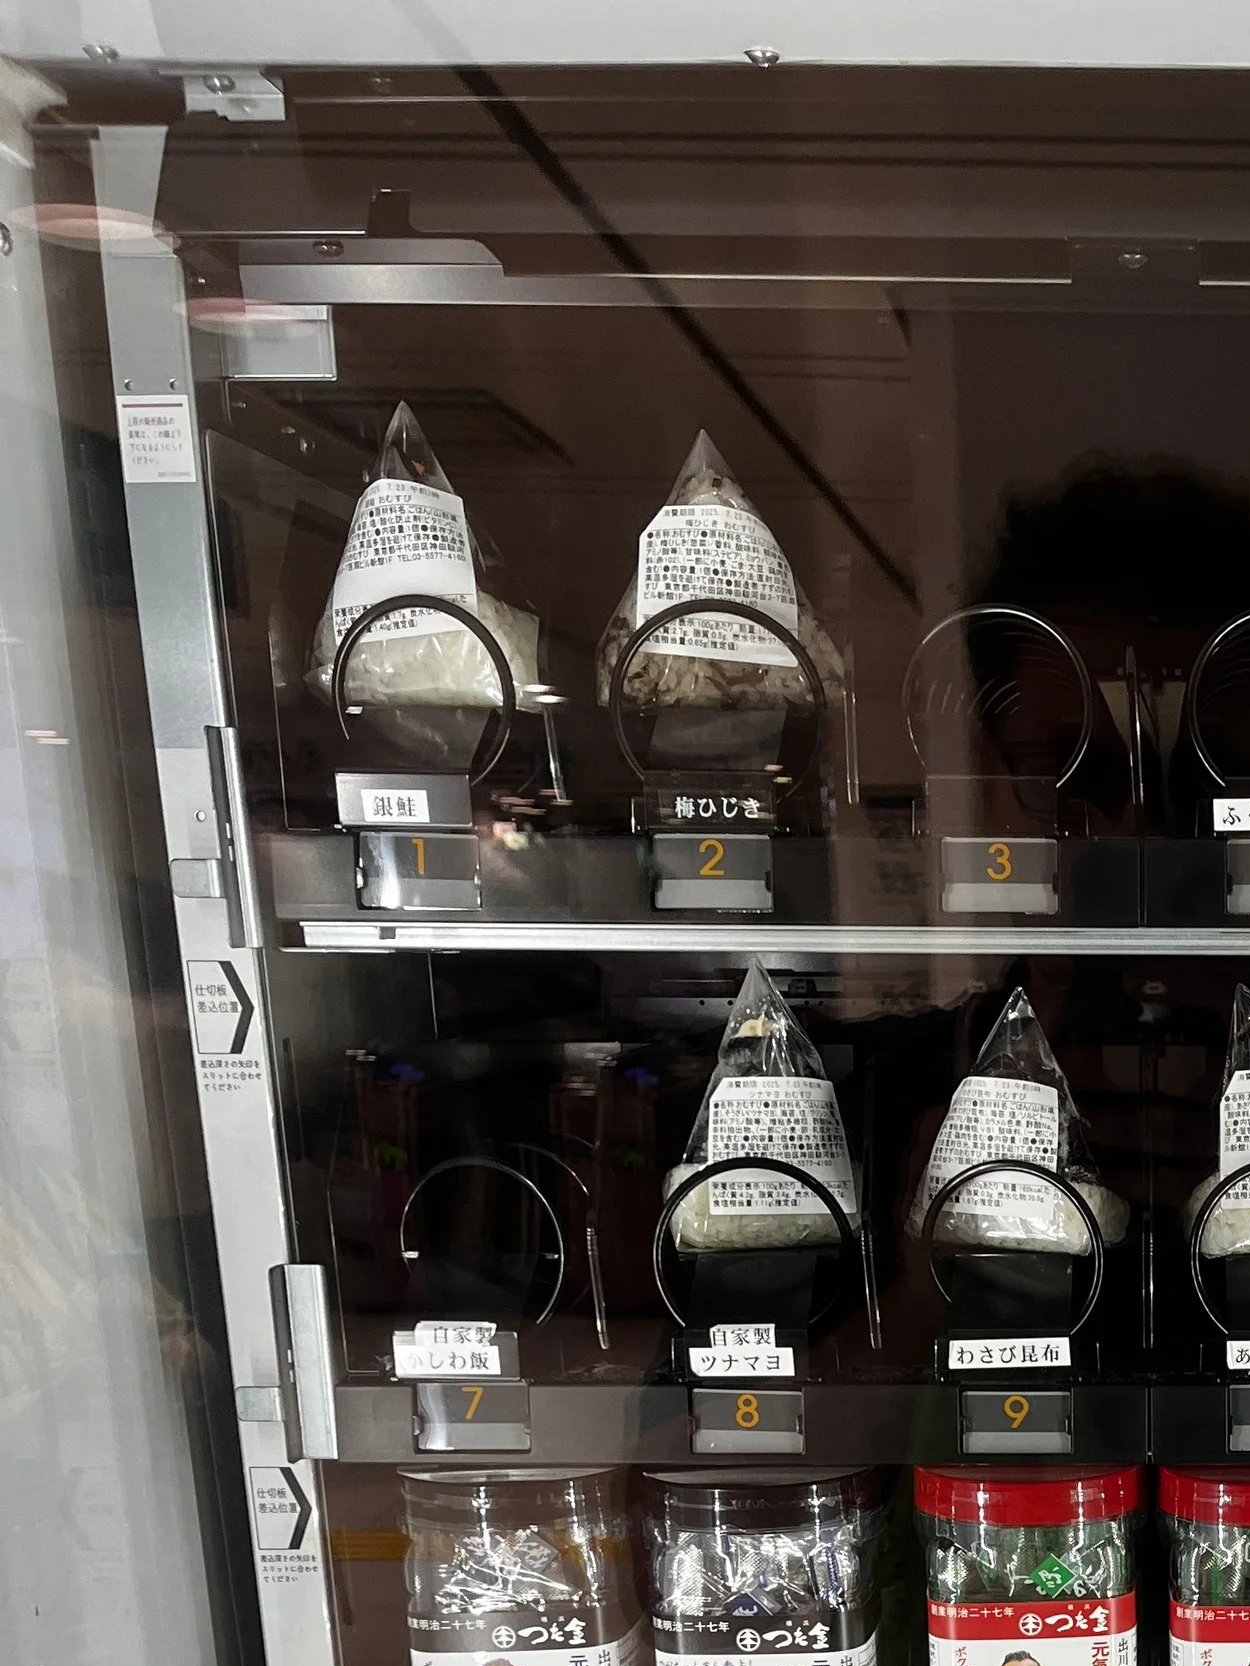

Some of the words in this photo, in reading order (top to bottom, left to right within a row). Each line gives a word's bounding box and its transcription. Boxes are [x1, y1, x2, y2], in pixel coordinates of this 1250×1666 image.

[374, 796, 417, 818] 銀鮭
[674, 796, 762, 820] 梅ひじき
[411, 838, 426, 876] 1
[700, 839, 726, 876] 2
[986, 843, 1013, 880] 3
[196, 984, 228, 996] 仕切板
[197, 1001, 240, 1013] 差込位置
[434, 1326, 496, 1345] 自家製
[713, 1328, 774, 1346] 自家製
[406, 1352, 489, 1371] かしわ飯
[700, 1354, 782, 1372] ツナマヨ
[956, 1344, 1060, 1364] わさび昆布
[461, 1387, 484, 1420] 7
[736, 1393, 760, 1428] 8
[1003, 1394, 1029, 1428] 9
